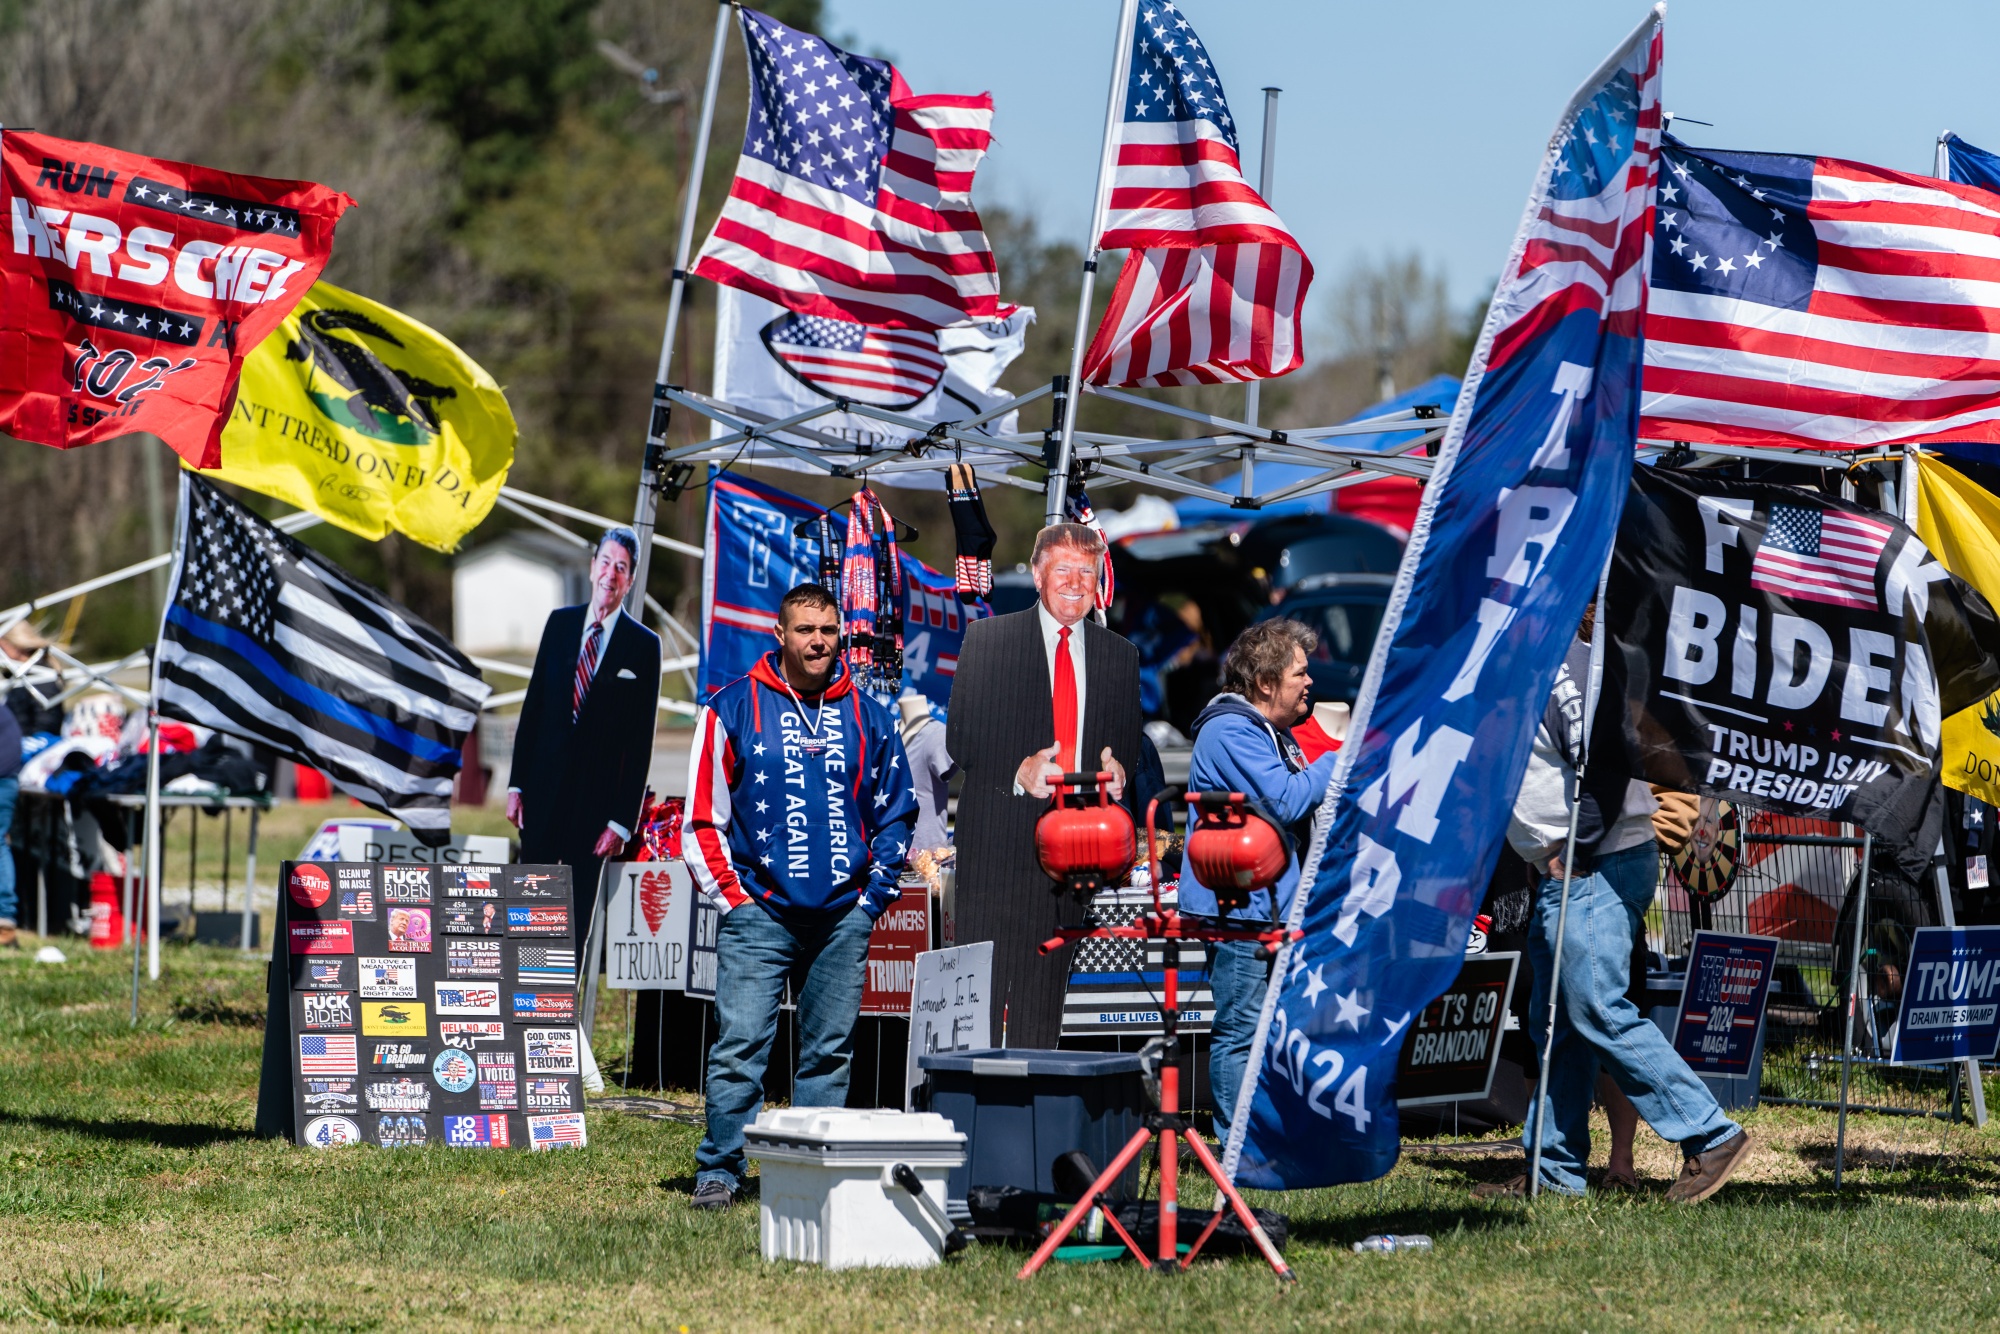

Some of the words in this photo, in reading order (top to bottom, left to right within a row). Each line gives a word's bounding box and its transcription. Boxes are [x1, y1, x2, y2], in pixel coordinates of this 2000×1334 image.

[37, 158, 118, 198] RUN
[11, 197, 306, 304] HERSCHEL
[279, 412, 349, 464] TREAD
[356, 452, 400, 481] ON
[1663, 586, 1939, 751] BIDEN
[800, 737, 827, 745] PERDUE
[822, 705, 845, 773] MAKE
[780, 712, 805, 789] GREAT
[1709, 724, 1818, 769] TRUMP
[1824, 751, 1851, 779] IS
[1851, 759, 1890, 783] MY
[1707, 758, 1858, 809] PRESIDENT
[786, 794, 809, 878] AGAIN!
[826, 778, 850, 886] AMERICA
[339, 869, 360, 878] CLEAN
[361, 869, 370, 878] UP
[384, 870, 429, 884] FUCK
[291, 876, 329, 890] DESANTIS
[340, 880, 350, 889] ON
[351, 880, 371, 889] AISLE
[384, 884, 430, 897] BIDEN
[448, 888, 464, 896] MY
[466, 888, 498, 896] TEXAS
[341, 892, 373, 914] 46
[627, 873, 640, 936] I
[538, 912, 567, 924] People
[879, 910, 925, 931] OWNERS
[449, 942, 500, 950] JESUS
[449, 958, 500, 967] TRUMP
[614, 942, 683, 981] TRUMP
[868, 960, 913, 992] TRUMP
[1698, 954, 1763, 1006] TRUMP
[437, 990, 496, 1007] TRUMP
[916, 980, 947, 1014] Lemonade
[954, 977, 964, 1006] Ice
[967, 974, 979, 1004] Tea
[304, 995, 350, 1009] FUCK
[543, 998, 573, 1010] People
[305, 1009, 352, 1022] BIDEN
[1419, 993, 1467, 1028] LET'S
[1473, 991, 1498, 1025] GO
[1100, 1012, 1127, 1023] BLUE
[1129, 1012, 1158, 1022] LIVES
[1707, 1006, 1736, 1032] 2024
[1911, 1010, 1940, 1026] DRAIN
[1942, 1009, 1959, 1024] THE
[1959, 1008, 1993, 1023] SWAMP
[485, 1024, 502, 1032] JOE
[375, 1044, 398, 1054] LET'S
[399, 1044, 411, 1053] GO
[1411, 1028, 1490, 1066] BRANDON
[1701, 1035, 1729, 1054] MAGA
[386, 1054, 426, 1064] BRANDON
[439, 1052, 448, 1061] IT'S
[449, 1050, 460, 1058] TIME
[460, 1053, 468, 1061] WE
[478, 1053, 494, 1064] HELL
[496, 1053, 514, 1064] YEAH
[530, 1057, 575, 1068] TRUMP.
[479, 1068, 482, 1081] I
[485, 1068, 515, 1081] VOTED
[1273, 1008, 1372, 1134] 2024
[309, 1083, 351, 1092] TRUMP
[373, 1083, 406, 1094] LET'S
[407, 1084, 423, 1094] GO
[441, 1081, 456, 1091] CIRCLE
[456, 1081, 469, 1091] BACK
[480, 1084, 516, 1099] TRUMP
[370, 1098, 429, 1109] BRANDON
[527, 1096, 571, 1106] BIDEN
[454, 1117, 475, 1128] JO
[316, 1124, 346, 1145] 45
[452, 1130, 476, 1141] HO
[491, 1122, 499, 1139] SAVE
[499, 1116, 507, 1145] AMERICA
